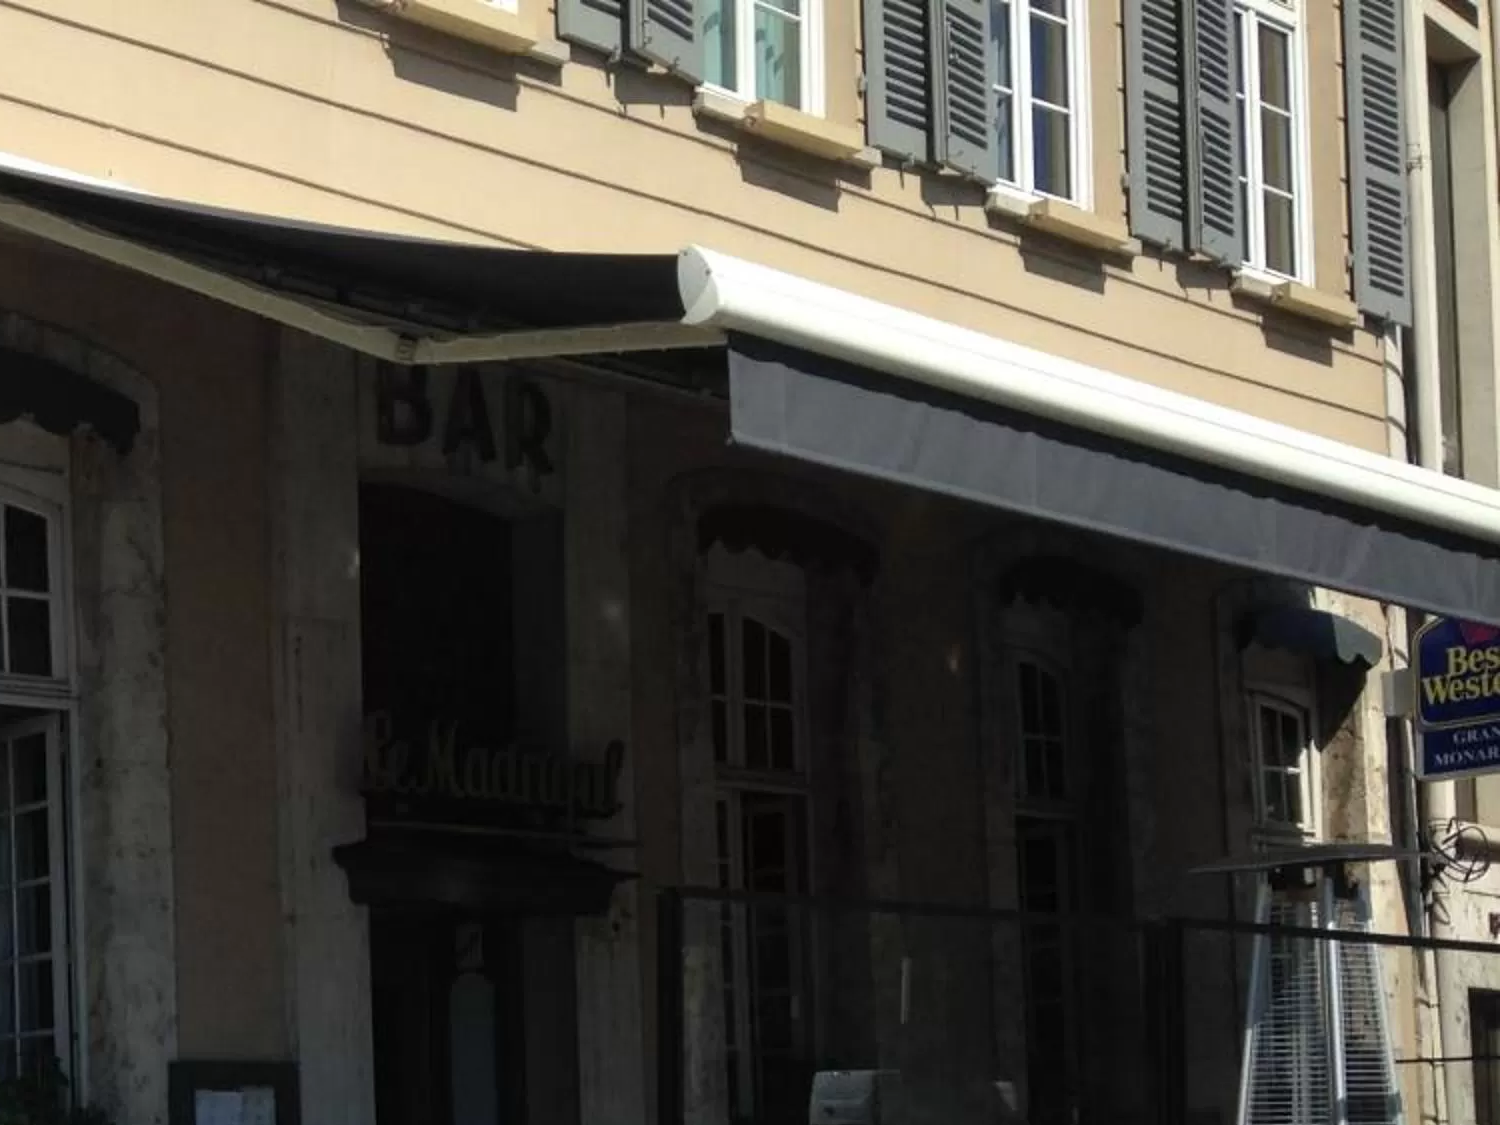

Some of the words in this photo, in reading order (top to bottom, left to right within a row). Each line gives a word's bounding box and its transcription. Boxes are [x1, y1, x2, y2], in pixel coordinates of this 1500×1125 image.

[376, 364, 554, 476] BAR
[1446, 645, 1500, 676] Bes
[1452, 727, 1500, 744] GRAN
[1434, 746, 1500, 767] MONAR
